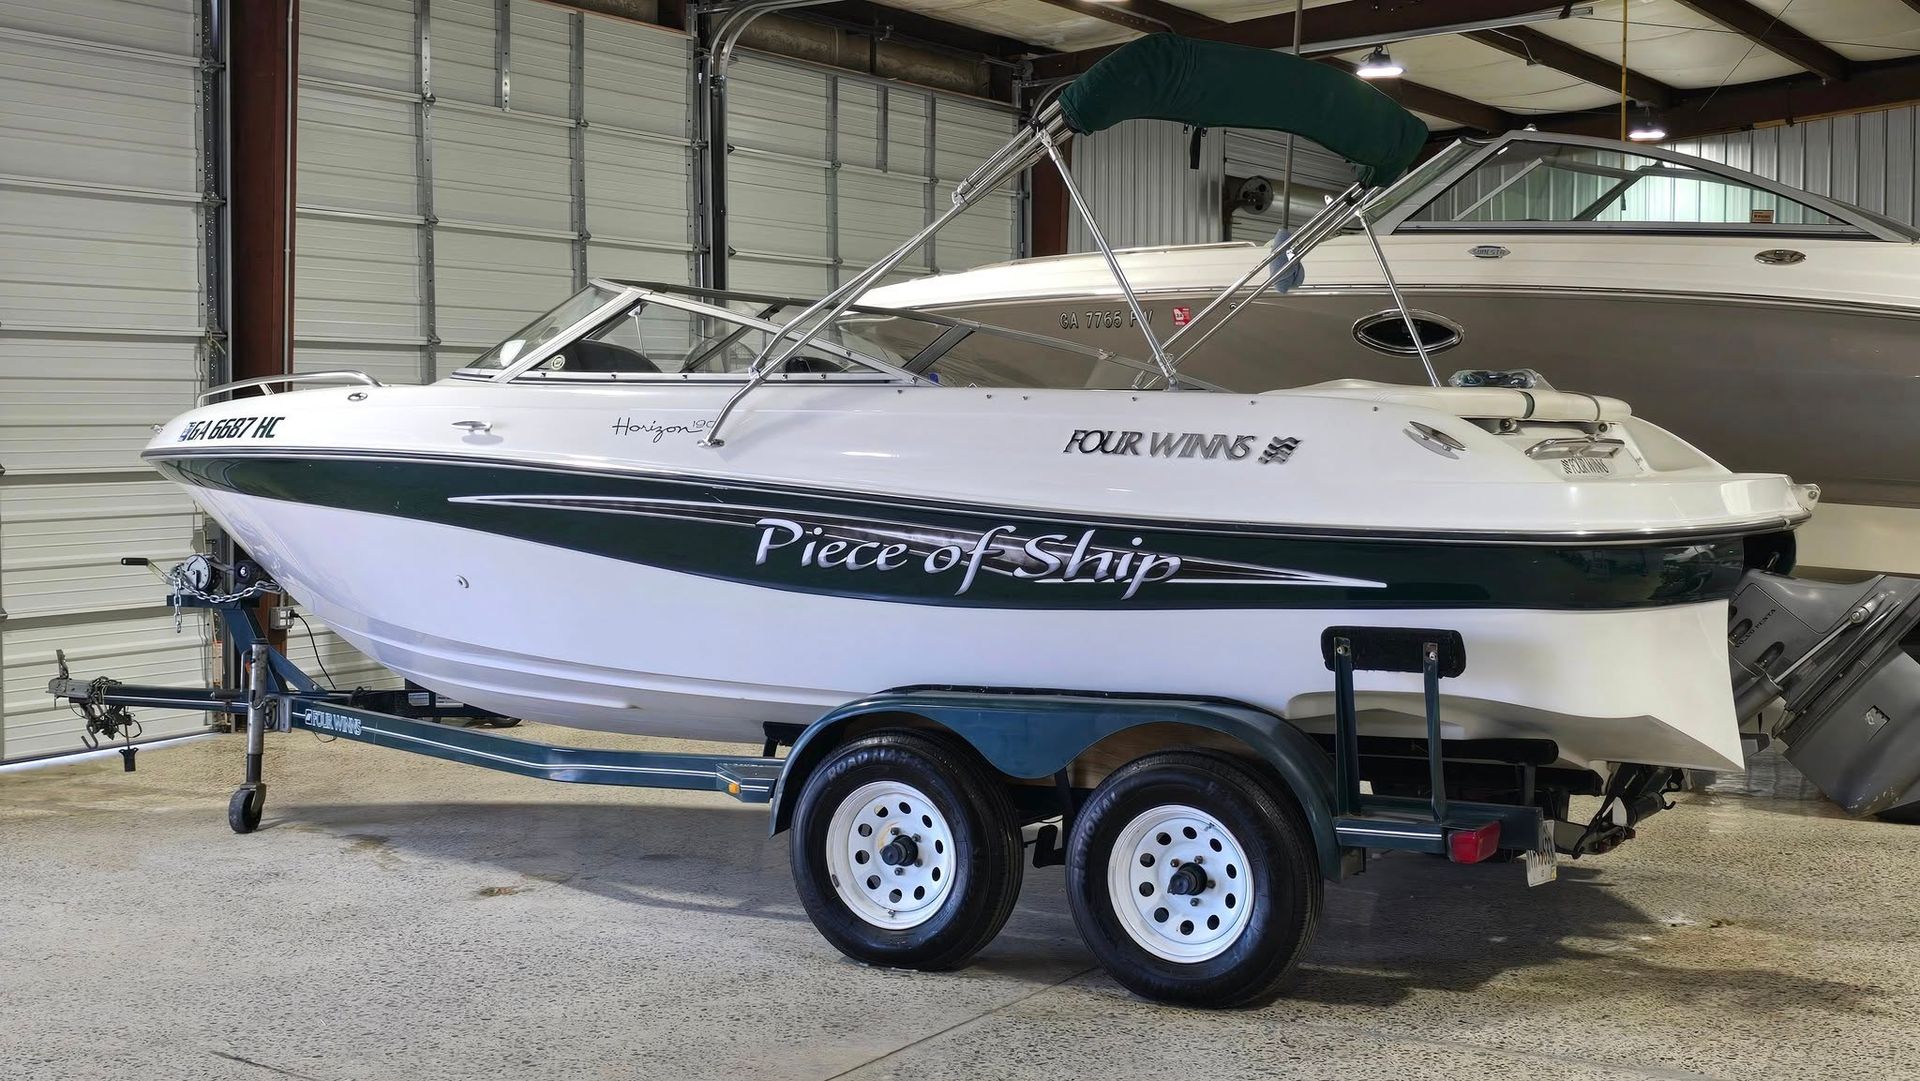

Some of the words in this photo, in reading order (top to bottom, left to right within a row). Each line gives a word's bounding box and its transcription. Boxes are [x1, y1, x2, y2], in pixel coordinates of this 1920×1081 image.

[1086, 310, 1122, 328] 7765
[187, 420, 213, 440] GA
[208, 416, 258, 440] 6687
[251, 416, 286, 439] HC
[612, 417, 703, 443] Horizon
[1063, 429, 1143, 456] FOUR
[1149, 431, 1256, 460] WINNS
[755, 518, 909, 570] Piece
[924, 525, 1017, 596] of
[1013, 529, 1182, 600] Ship
[312, 709, 334, 731] FOUR
[332, 713, 362, 736] WINNS
